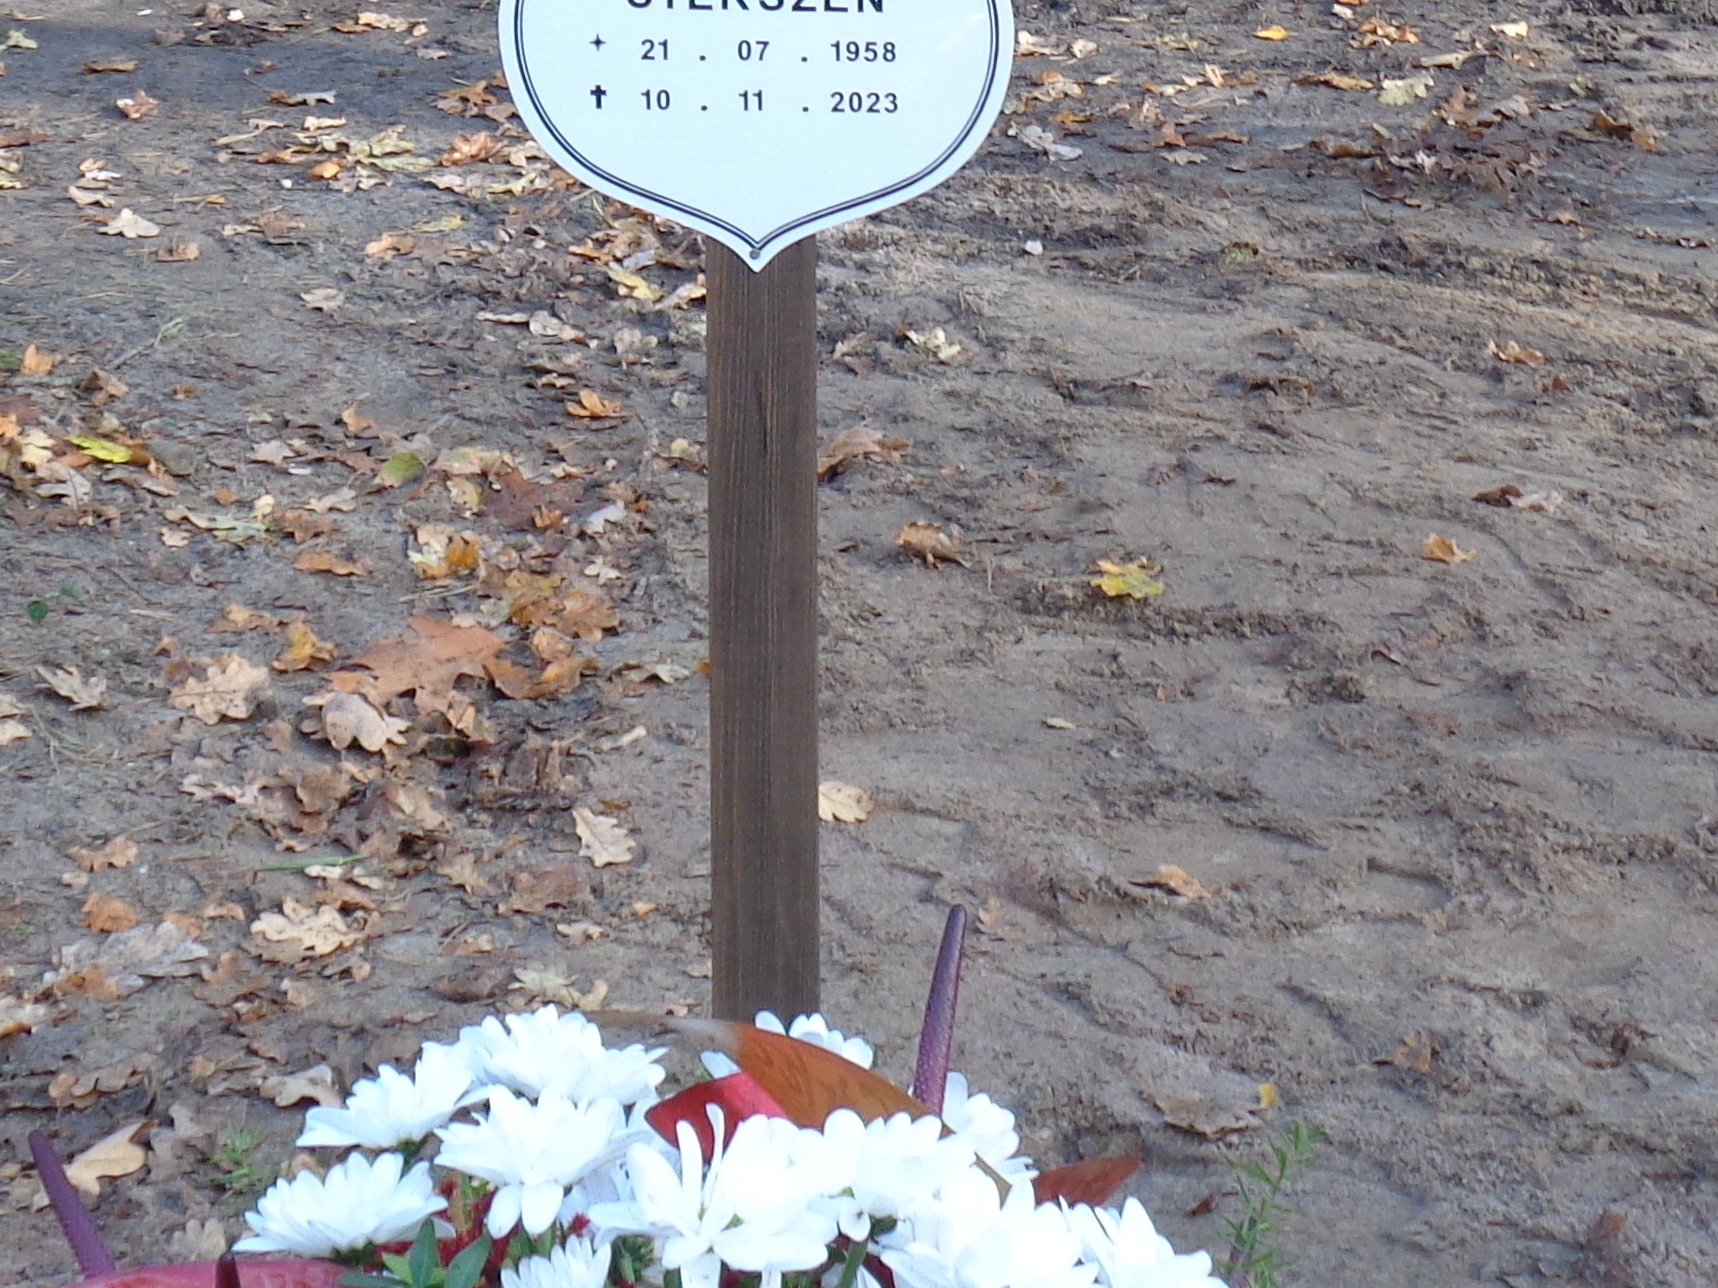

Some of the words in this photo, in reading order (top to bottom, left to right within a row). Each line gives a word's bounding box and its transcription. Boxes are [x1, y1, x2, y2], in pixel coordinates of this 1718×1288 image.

[641, 38, 669, 61] 21
[737, 39, 770, 62] 07
[830, 40, 897, 63] 1958
[640, 88, 671, 111] 10
[738, 89, 764, 112] 11
[830, 91, 899, 114] 2023
